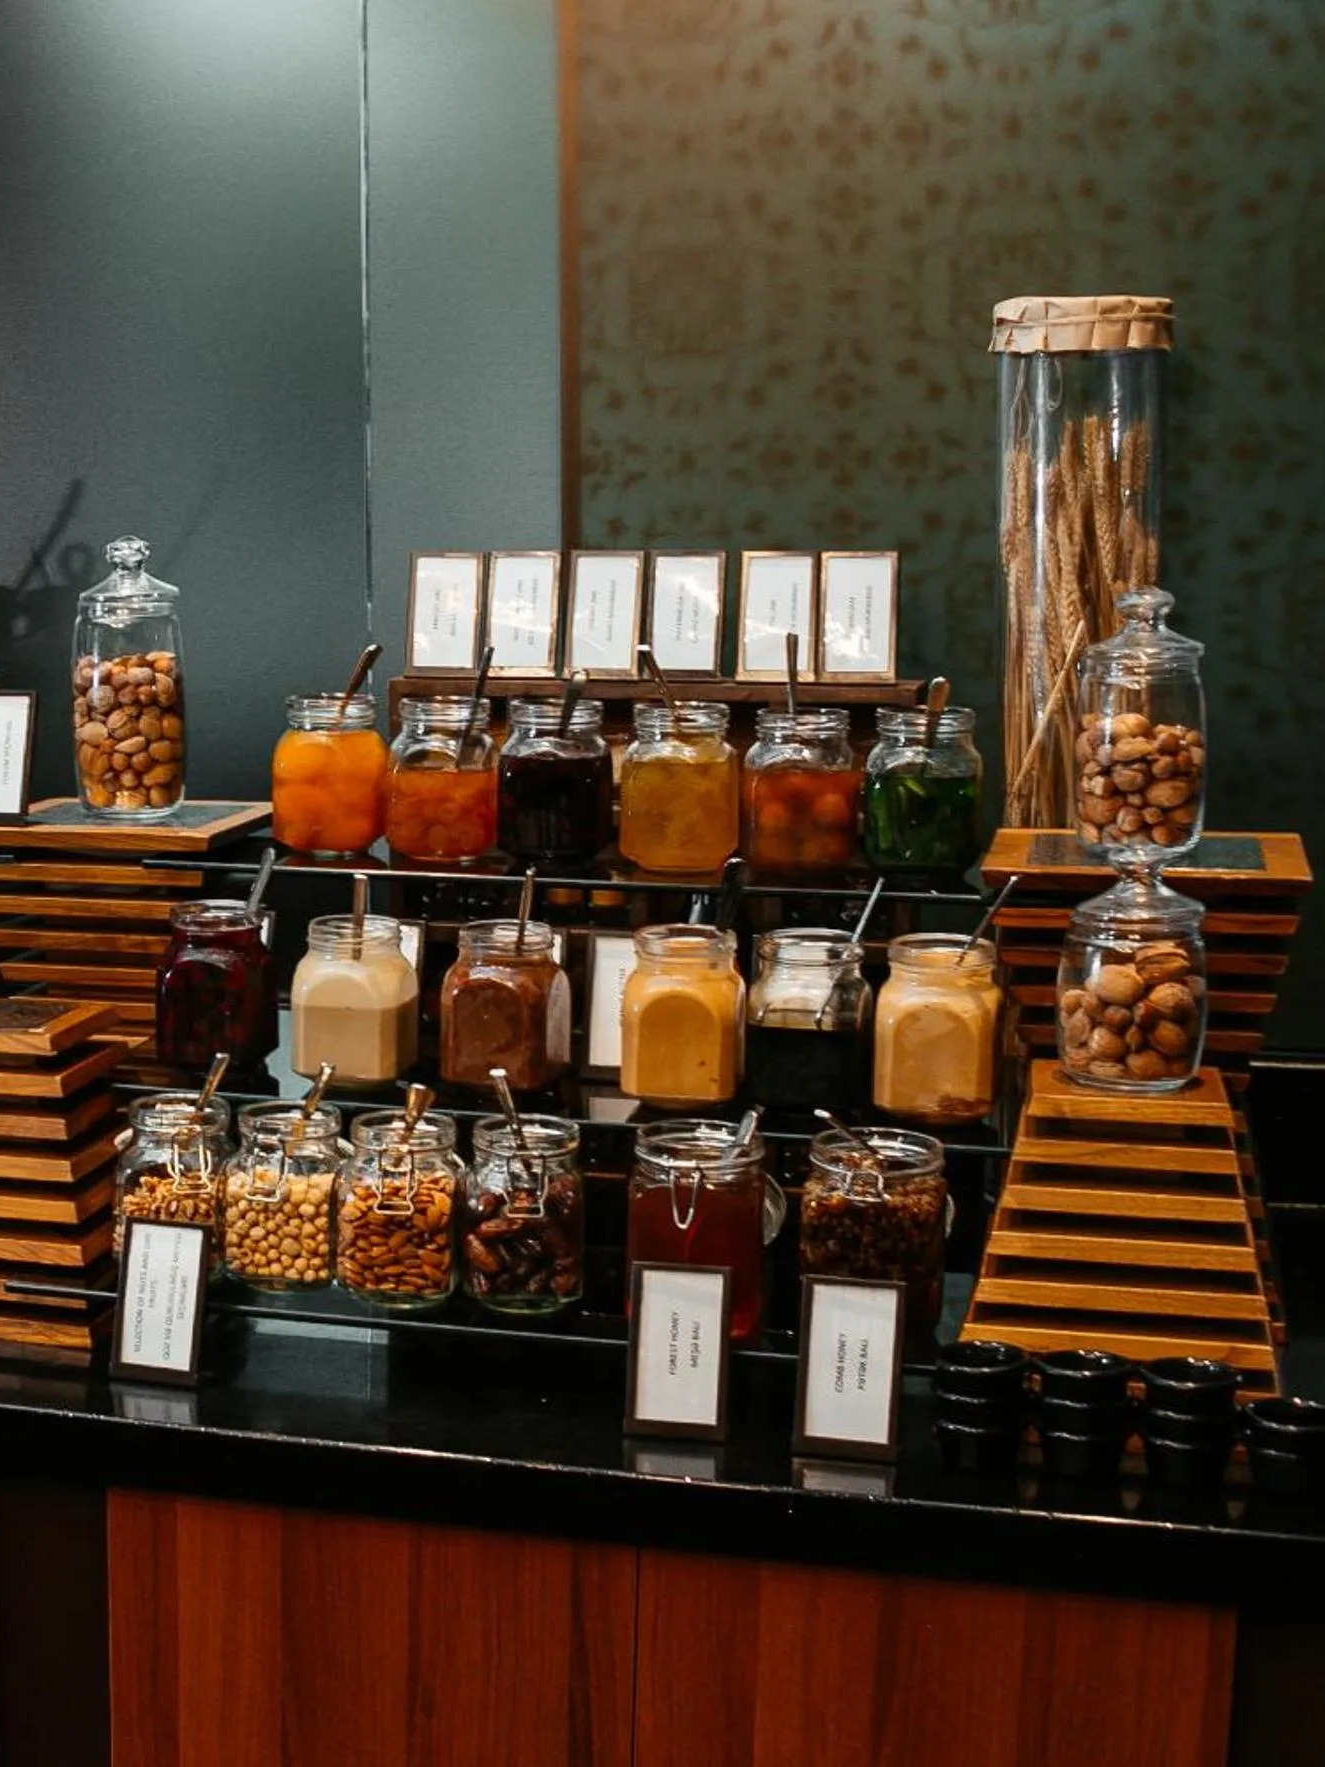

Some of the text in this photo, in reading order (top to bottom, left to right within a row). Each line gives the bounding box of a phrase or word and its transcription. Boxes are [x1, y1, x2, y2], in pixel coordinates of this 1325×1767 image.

[669, 1312, 680, 1376] FOREST HONEY
[835, 1332, 847, 1393] COMB HONEY
